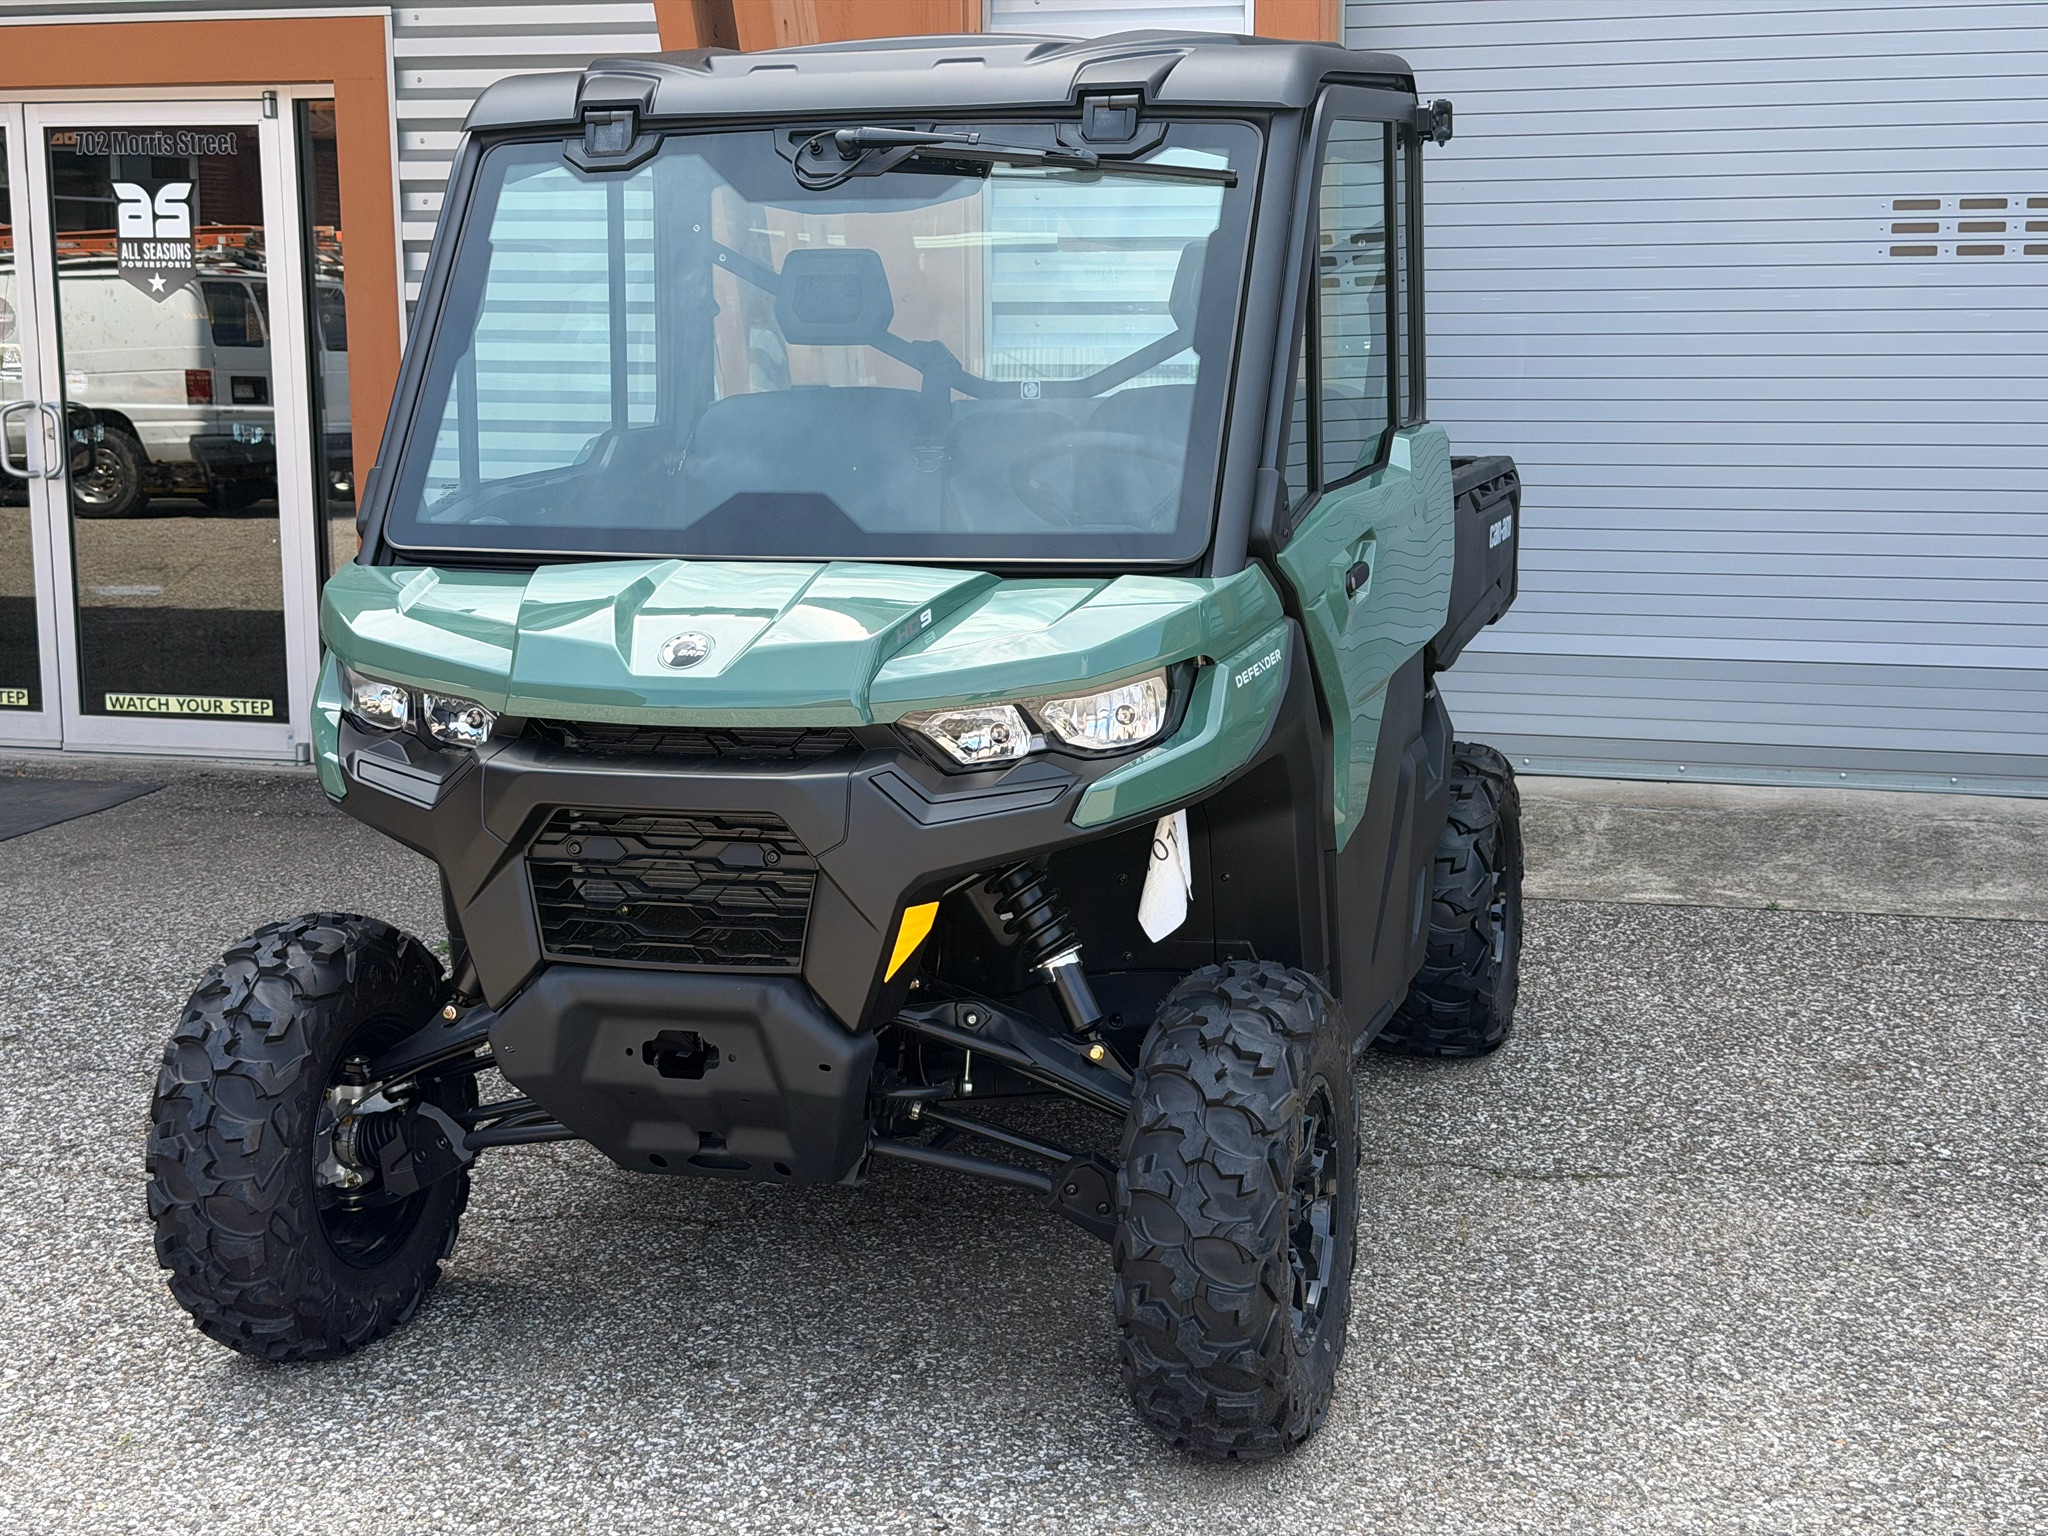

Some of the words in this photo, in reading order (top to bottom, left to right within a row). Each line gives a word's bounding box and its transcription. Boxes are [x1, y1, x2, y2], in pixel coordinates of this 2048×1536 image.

[75, 131, 109, 156] 702
[111, 131, 174, 156] Morris
[176, 131, 237, 156] Street
[121, 242, 140, 260] ALL
[143, 242, 191, 260] SEASONS
[677, 648, 705, 657] BRP
[1235, 648, 1281, 688] DEFENDER
[109, 696, 170, 712] WATCH
[176, 698, 224, 713] YOUR
[230, 700, 270, 715] STEP
